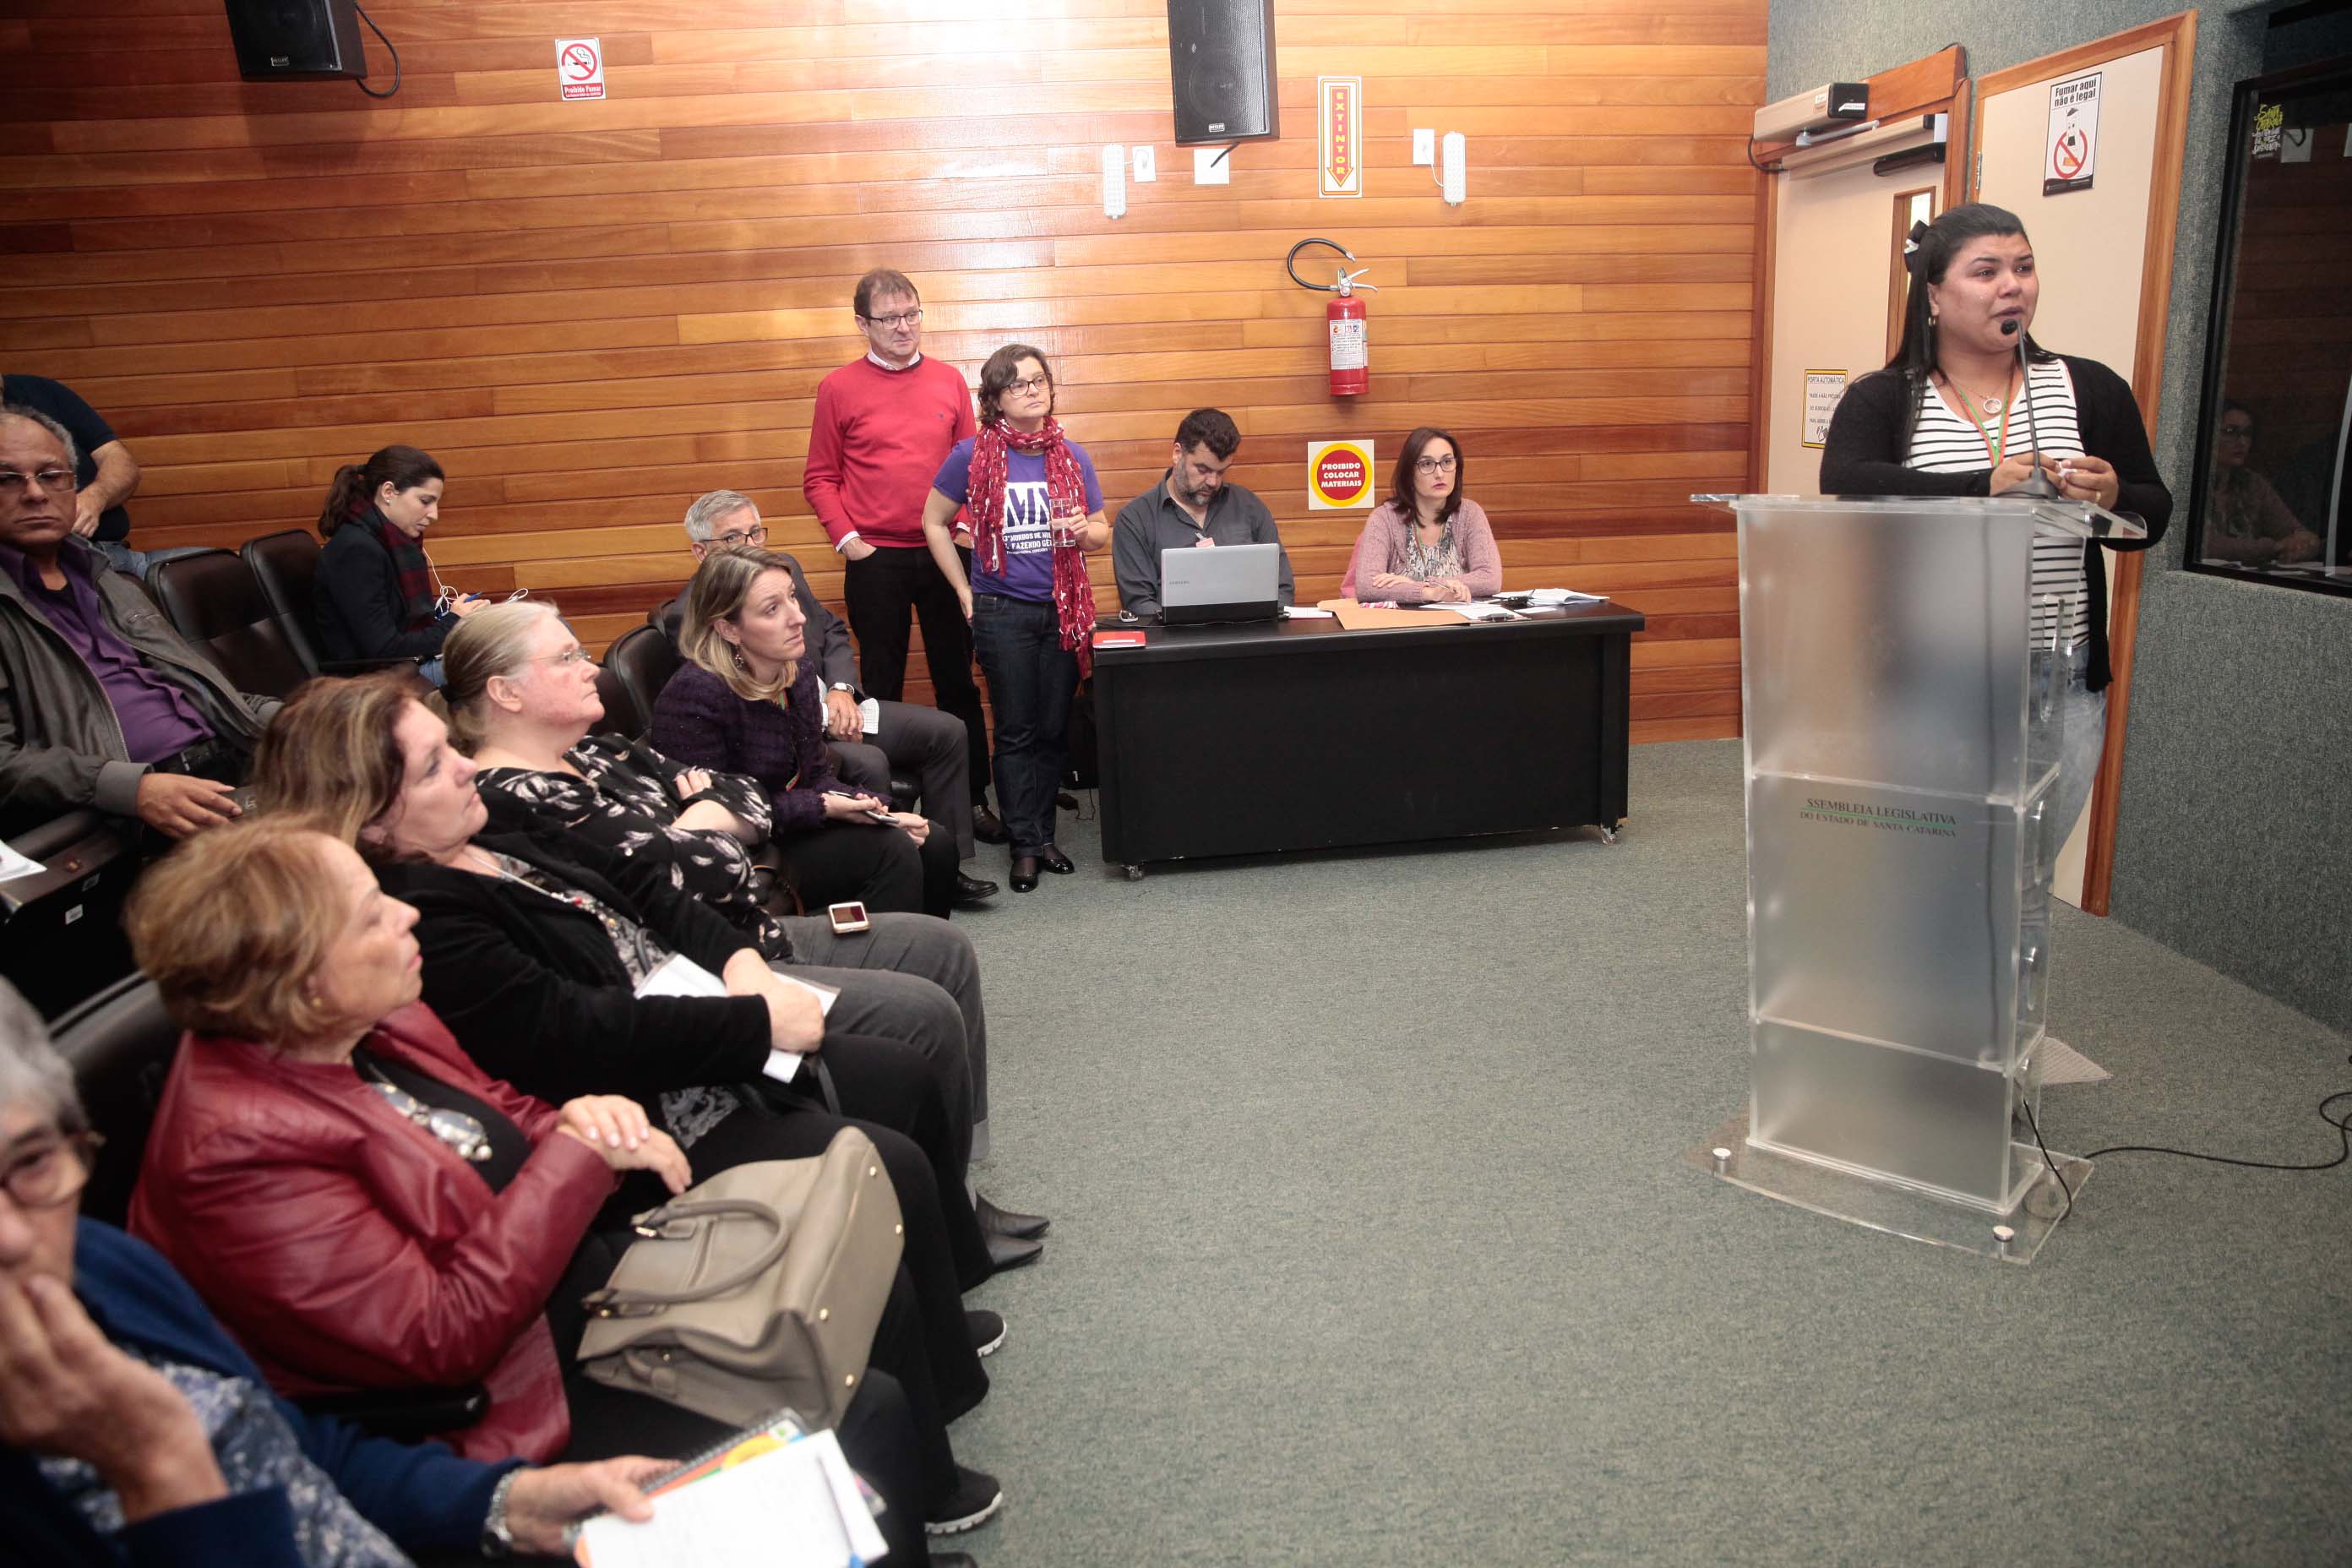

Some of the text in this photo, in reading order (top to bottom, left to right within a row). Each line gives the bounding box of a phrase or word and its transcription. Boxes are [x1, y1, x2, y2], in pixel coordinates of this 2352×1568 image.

[2055, 77, 2097, 97] Fumar aqui
[2055, 88, 2096, 107] não é legal
[1336, 91, 1346, 175] EXTINTOR
[1321, 462, 1361, 471] PROIBIDO
[1011, 541, 1041, 550] FAZENDO
[1799, 811, 1814, 819] DO
[1816, 813, 1854, 825] ESTADO
[1872, 820, 1903, 832] SANTA
[1906, 824, 1957, 838] CATARINA
[1876, 805, 1957, 825] LEGISLATIVA
